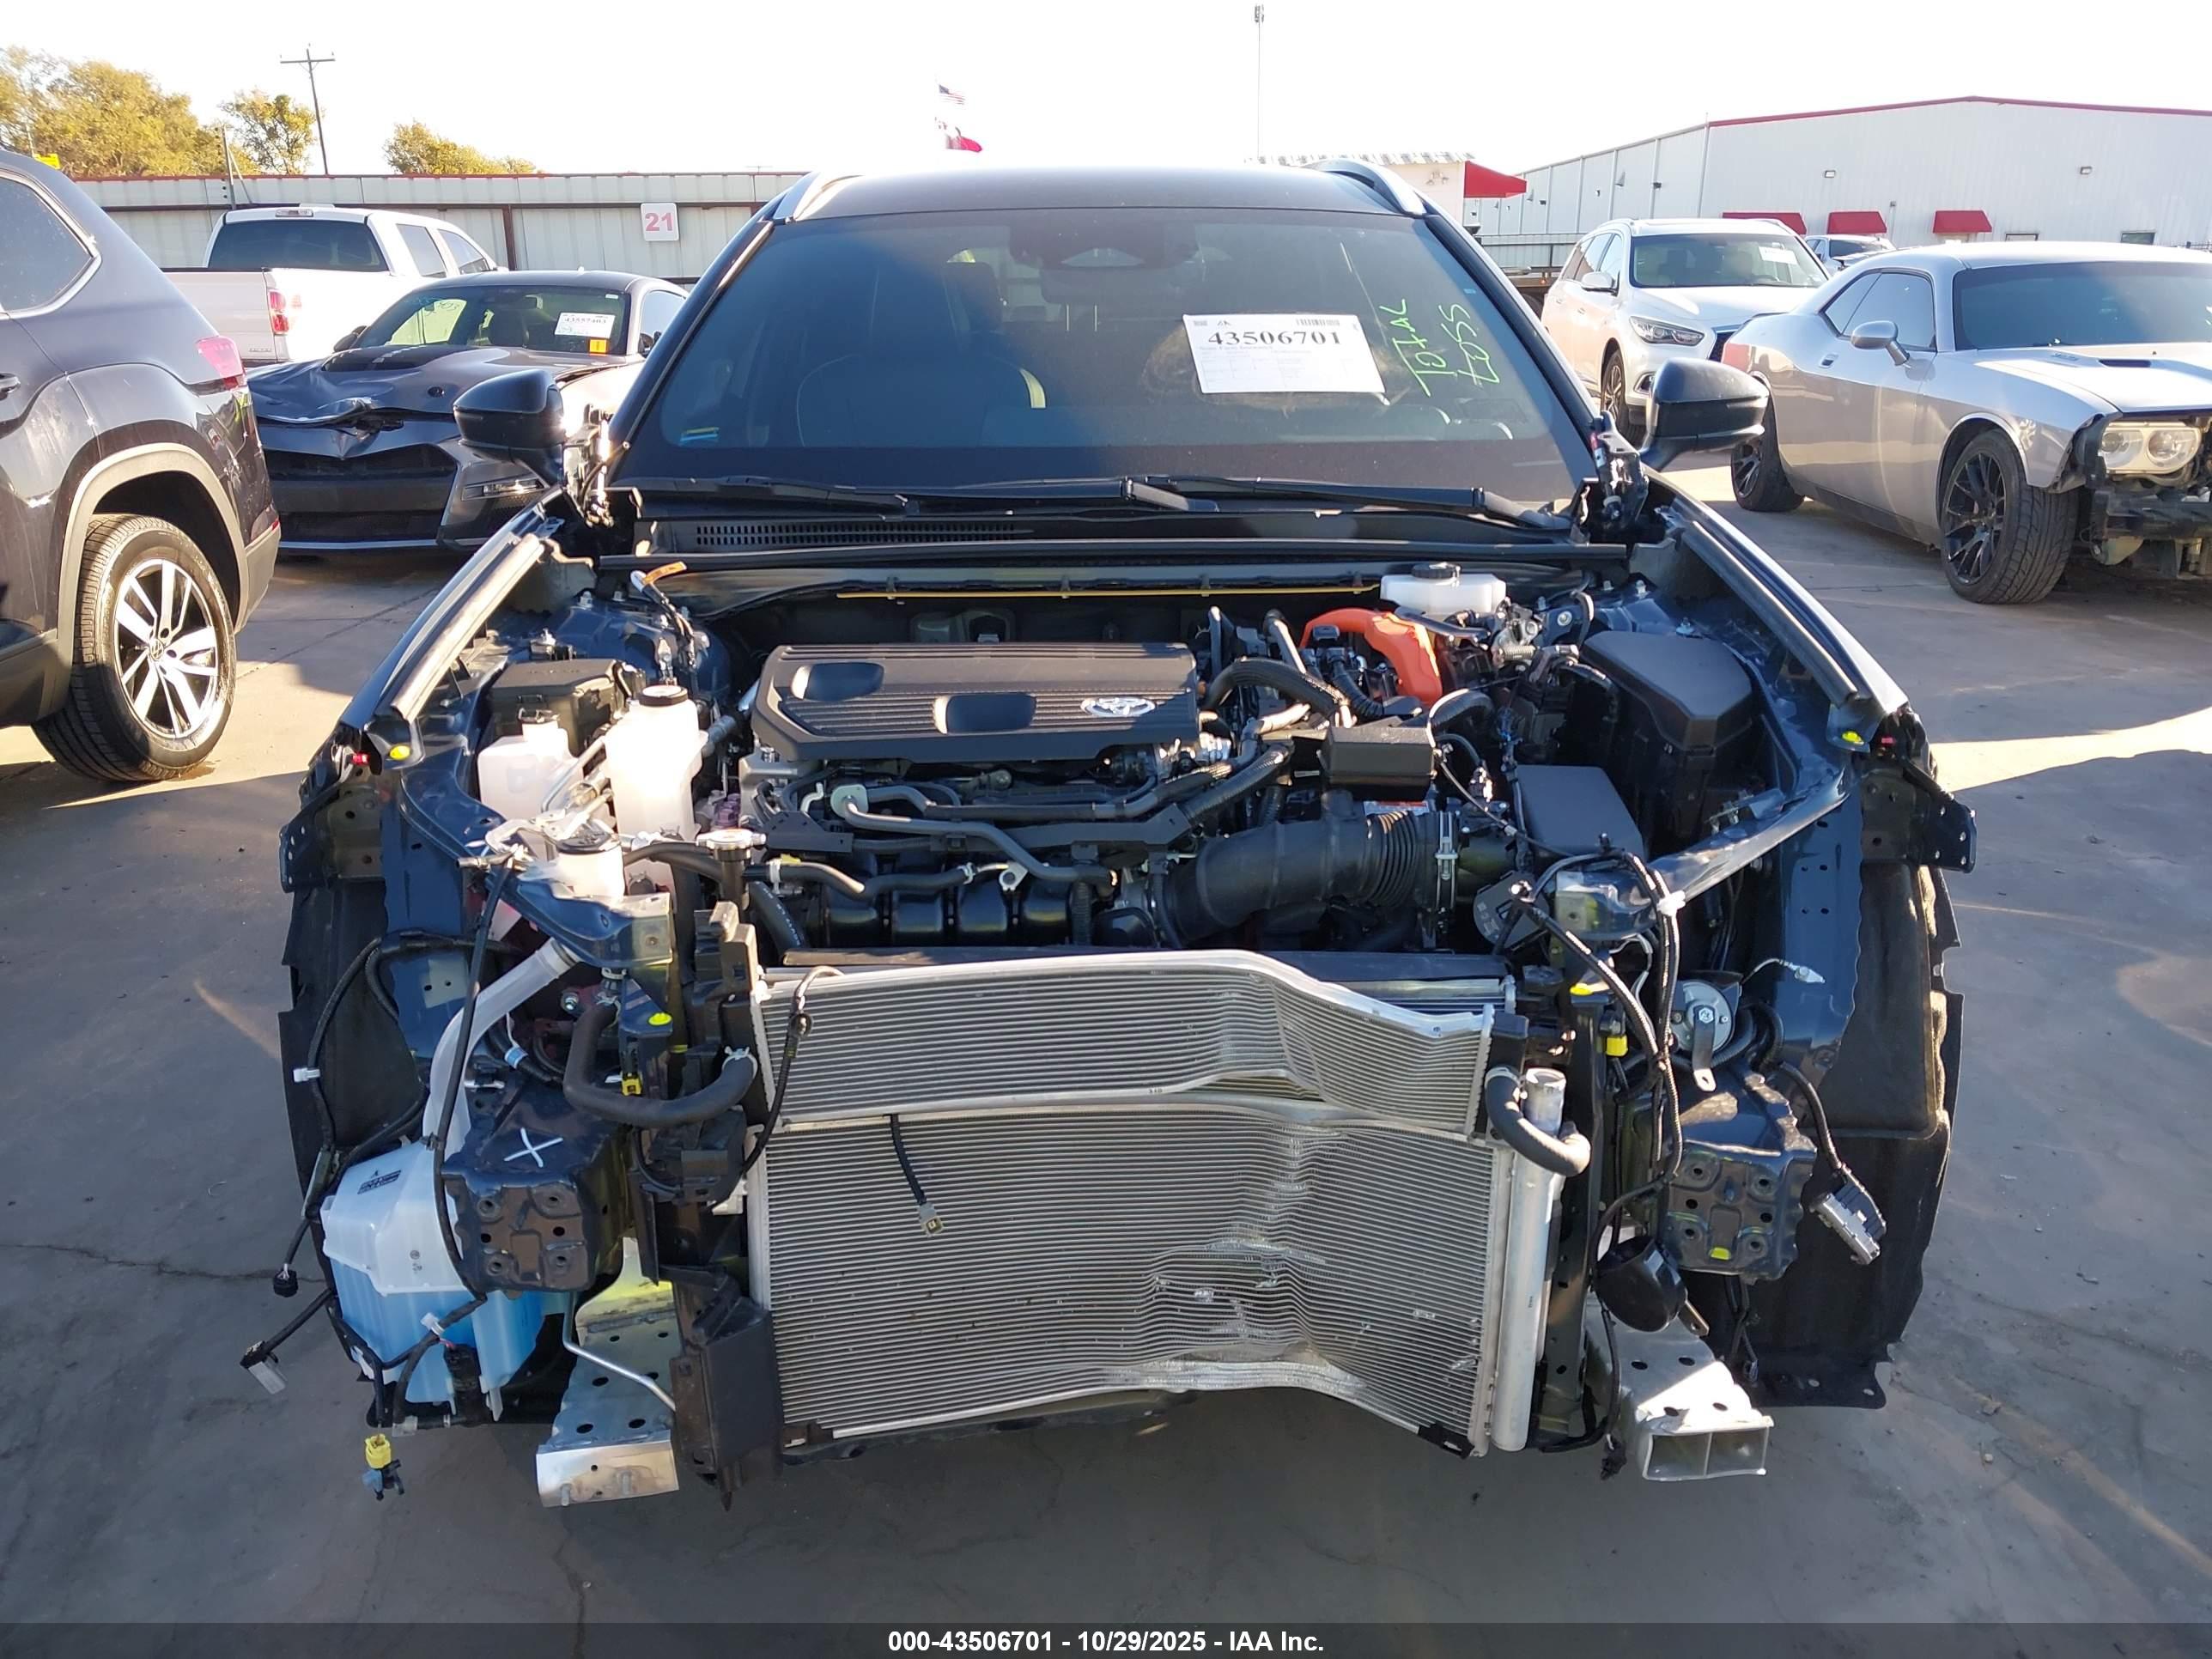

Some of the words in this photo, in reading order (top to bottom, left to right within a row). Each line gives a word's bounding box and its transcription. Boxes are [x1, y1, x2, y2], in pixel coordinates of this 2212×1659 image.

[645, 212, 673, 232] 21
[1208, 331, 1341, 345] 43506701
[1379, 299, 1458, 397] TOTAL
[1438, 304, 1500, 386] LOSS
